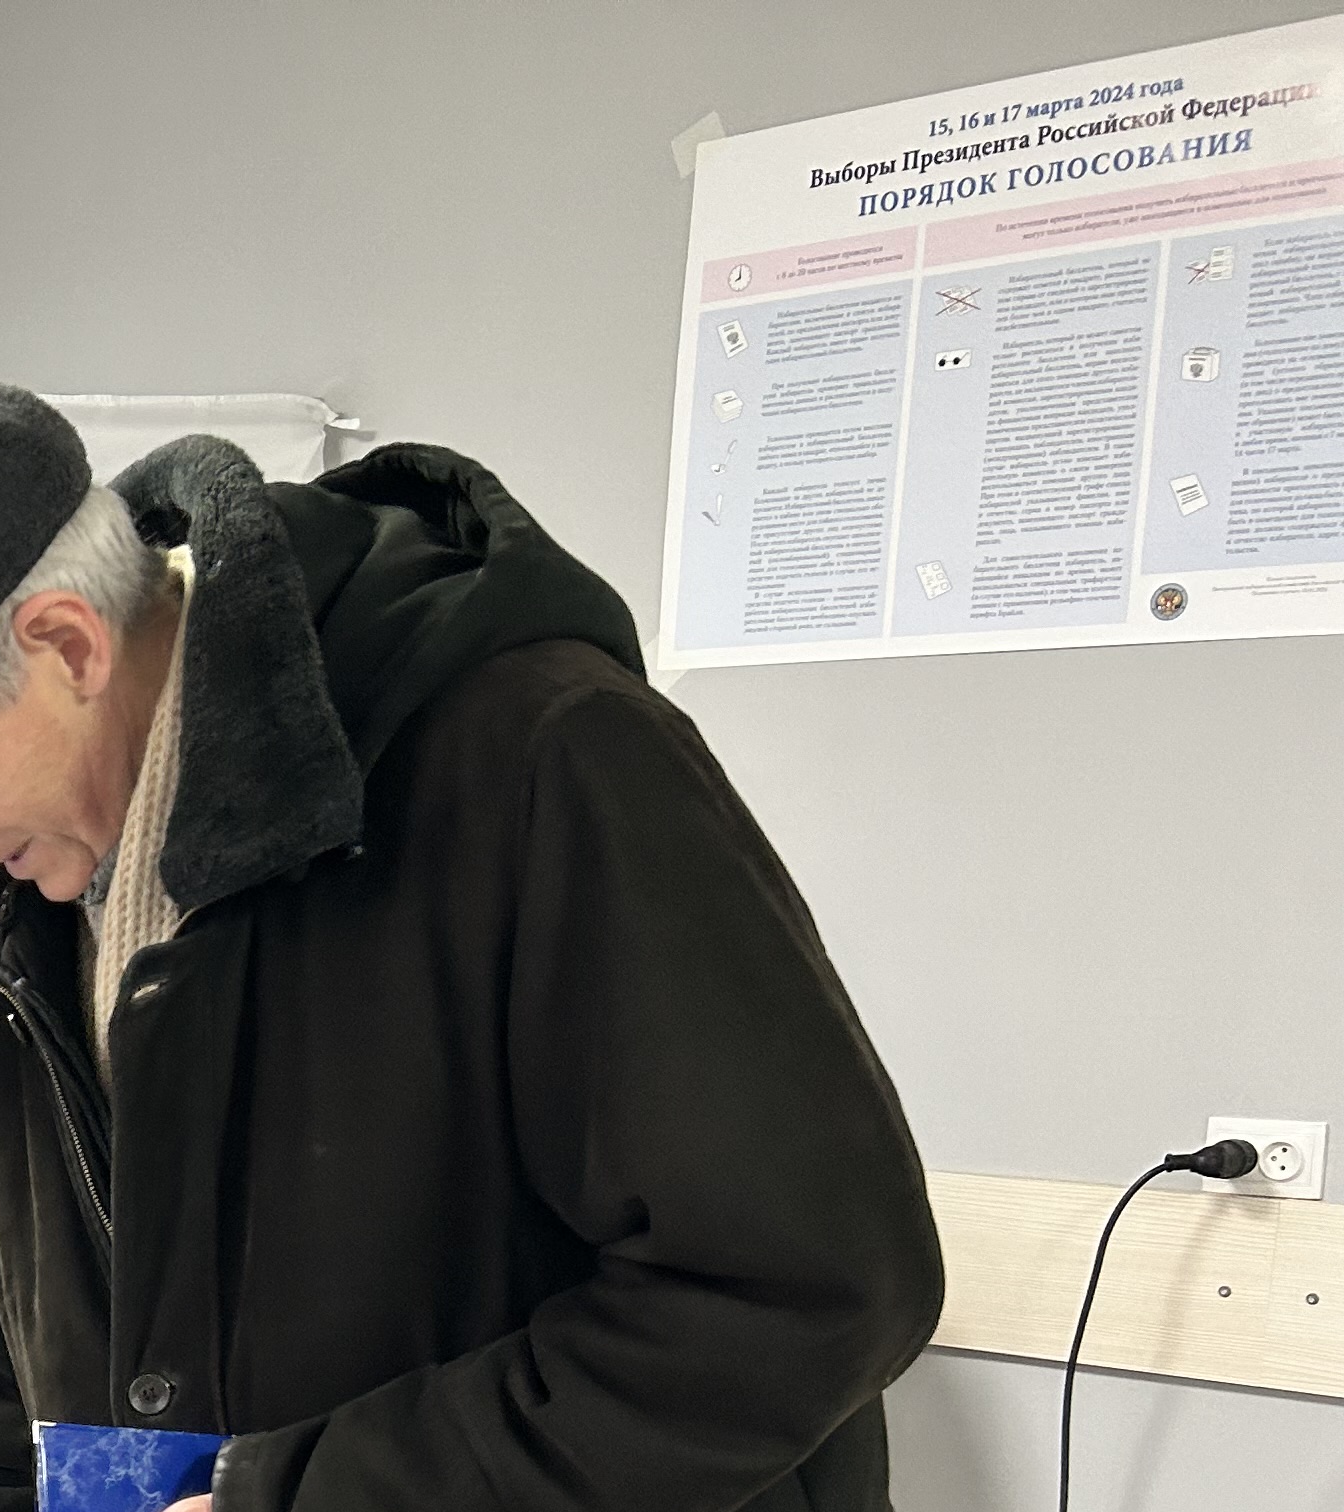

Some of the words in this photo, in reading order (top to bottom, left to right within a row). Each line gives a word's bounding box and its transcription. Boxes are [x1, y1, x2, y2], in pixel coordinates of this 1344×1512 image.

[810, 159, 896, 188] Выборы
[902, 132, 1030, 174] Президента
[1037, 103, 1175, 146] Российской
[929, 118, 954, 138] 15,
[960, 112, 979, 131] 16
[983, 111, 995, 126] и
[1002, 104, 1021, 123] 17
[1026, 94, 1083, 118] марта
[1088, 83, 1134, 108] 2024
[1141, 77, 1188, 97] года
[858, 172, 997, 217] ПОРЯДОК
[1007, 128, 1253, 190] ГОЛОСОВАНИЯ
